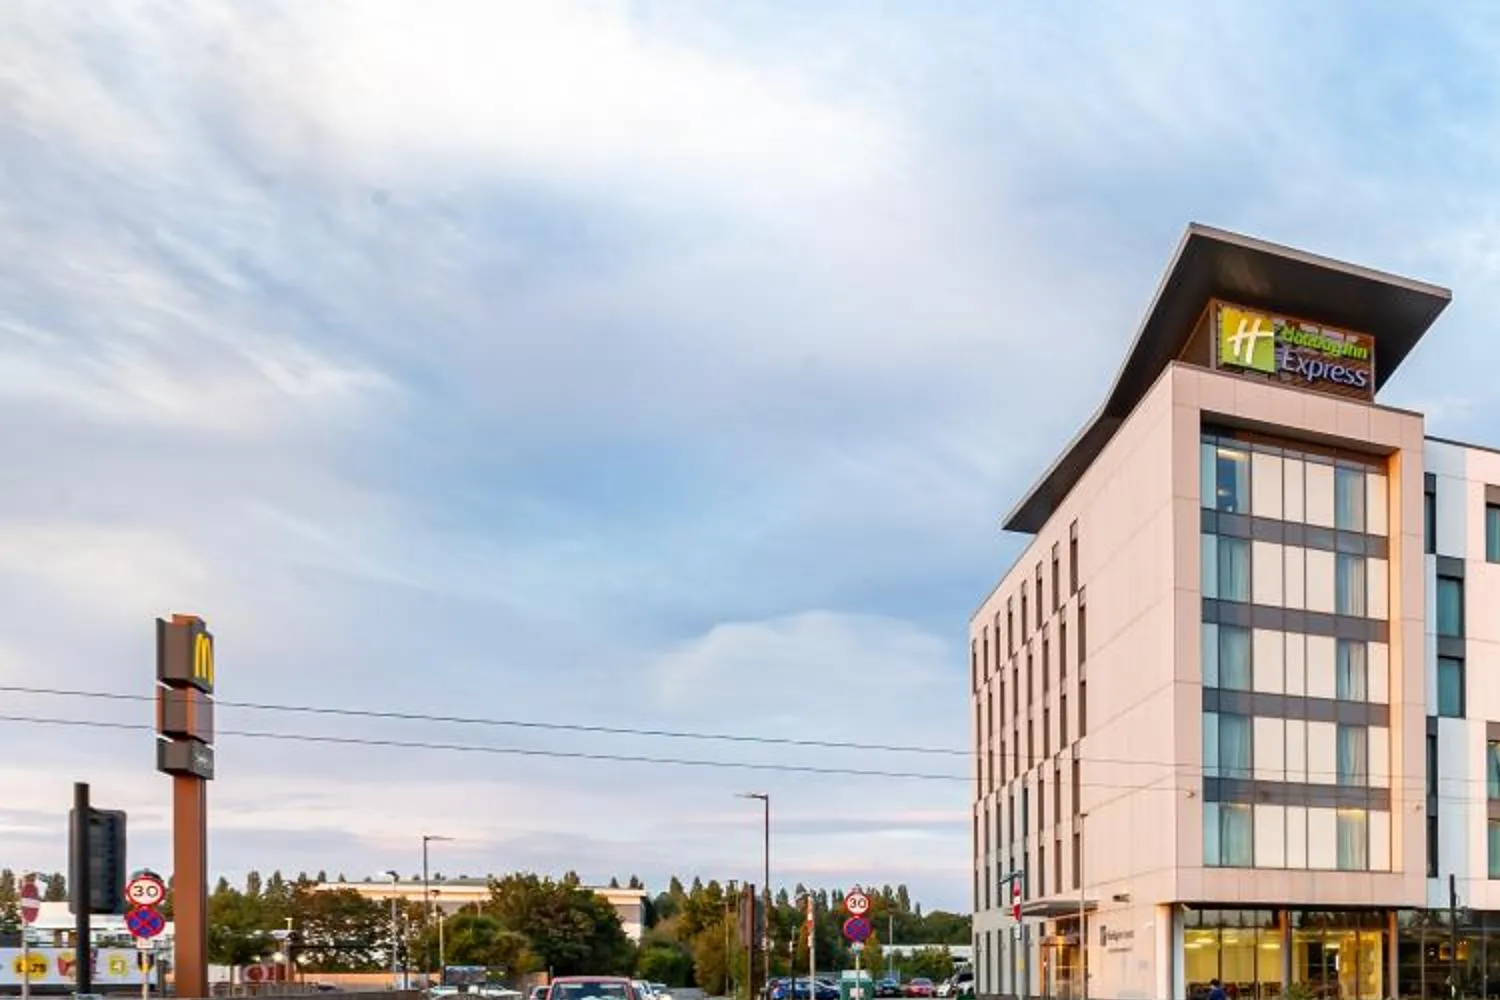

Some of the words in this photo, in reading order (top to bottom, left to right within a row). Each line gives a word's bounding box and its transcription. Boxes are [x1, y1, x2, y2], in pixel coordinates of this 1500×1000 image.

[1281, 348, 1369, 387] Express
[133, 885, 158, 898] 30
[849, 897, 867, 909] 30
